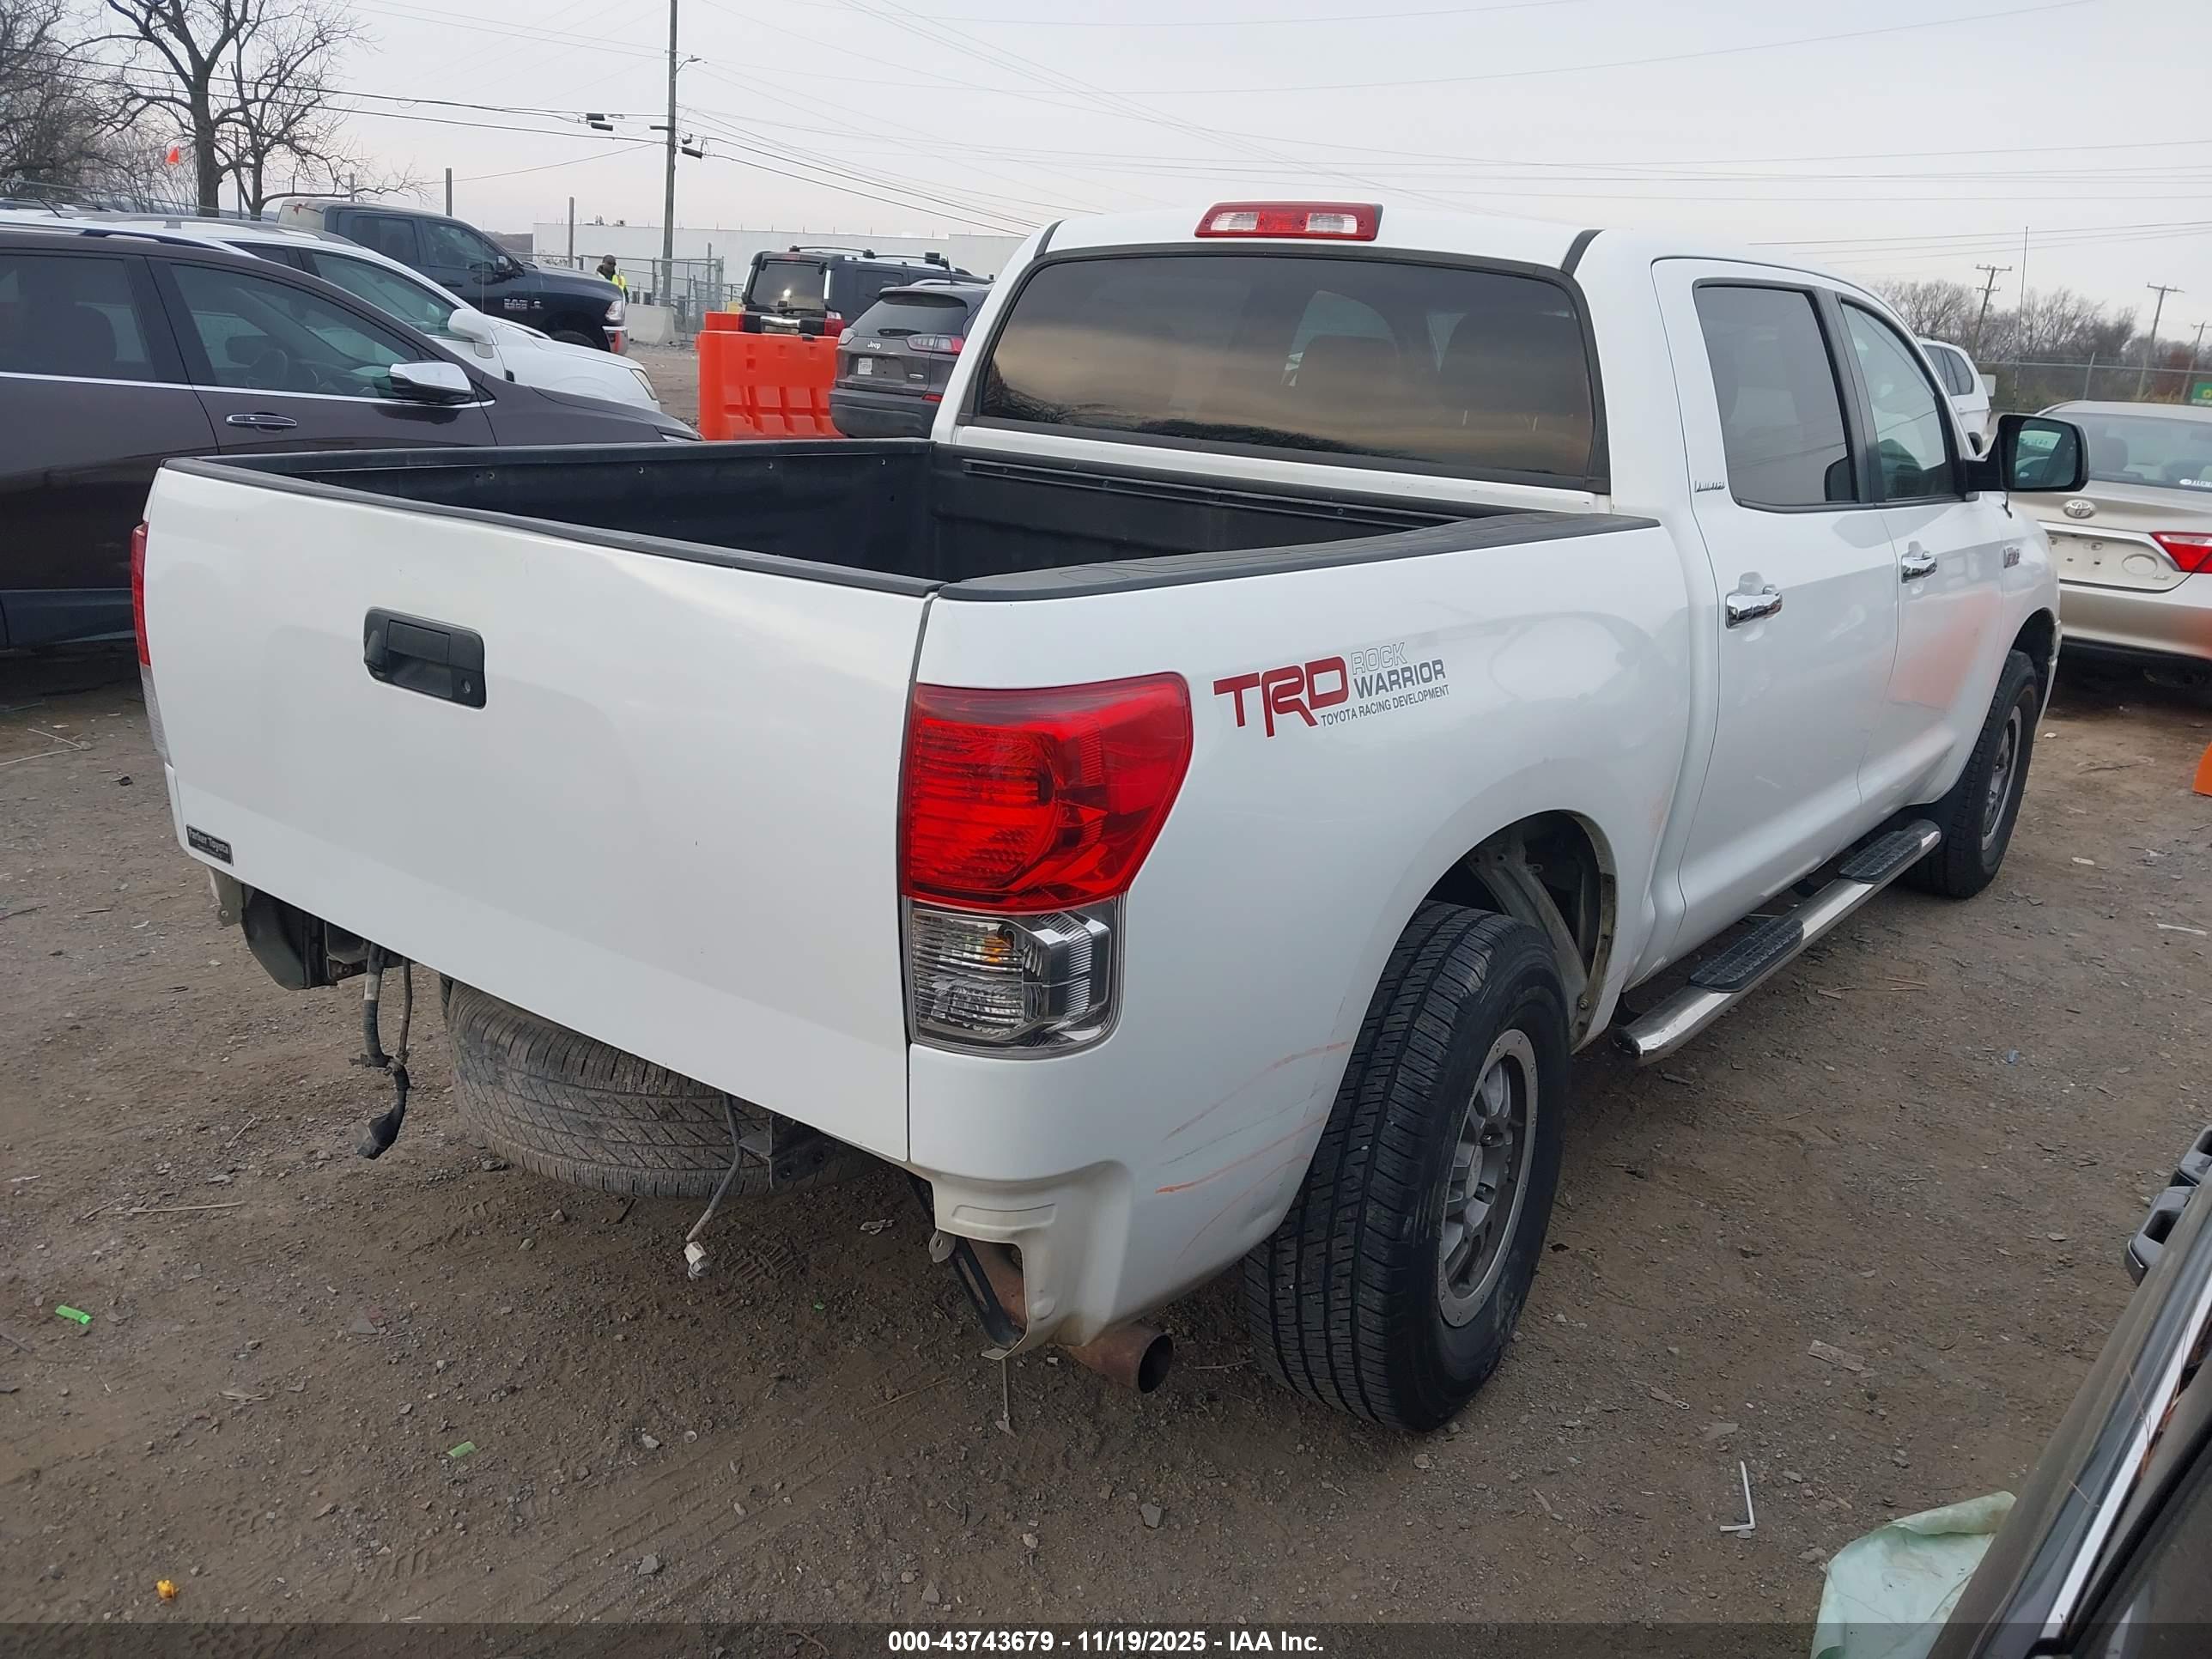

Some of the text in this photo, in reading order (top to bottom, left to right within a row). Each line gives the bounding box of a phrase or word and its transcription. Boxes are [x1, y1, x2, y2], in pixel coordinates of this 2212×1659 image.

[867, 341, 881, 350] Jeep
[1351, 642, 1408, 676] ROCK
[1353, 659, 1447, 699] WARRIOR
[1212, 656, 1350, 738] TRD
[1321, 684, 1450, 727] TOYOTA RACING DEVELOPMENT
